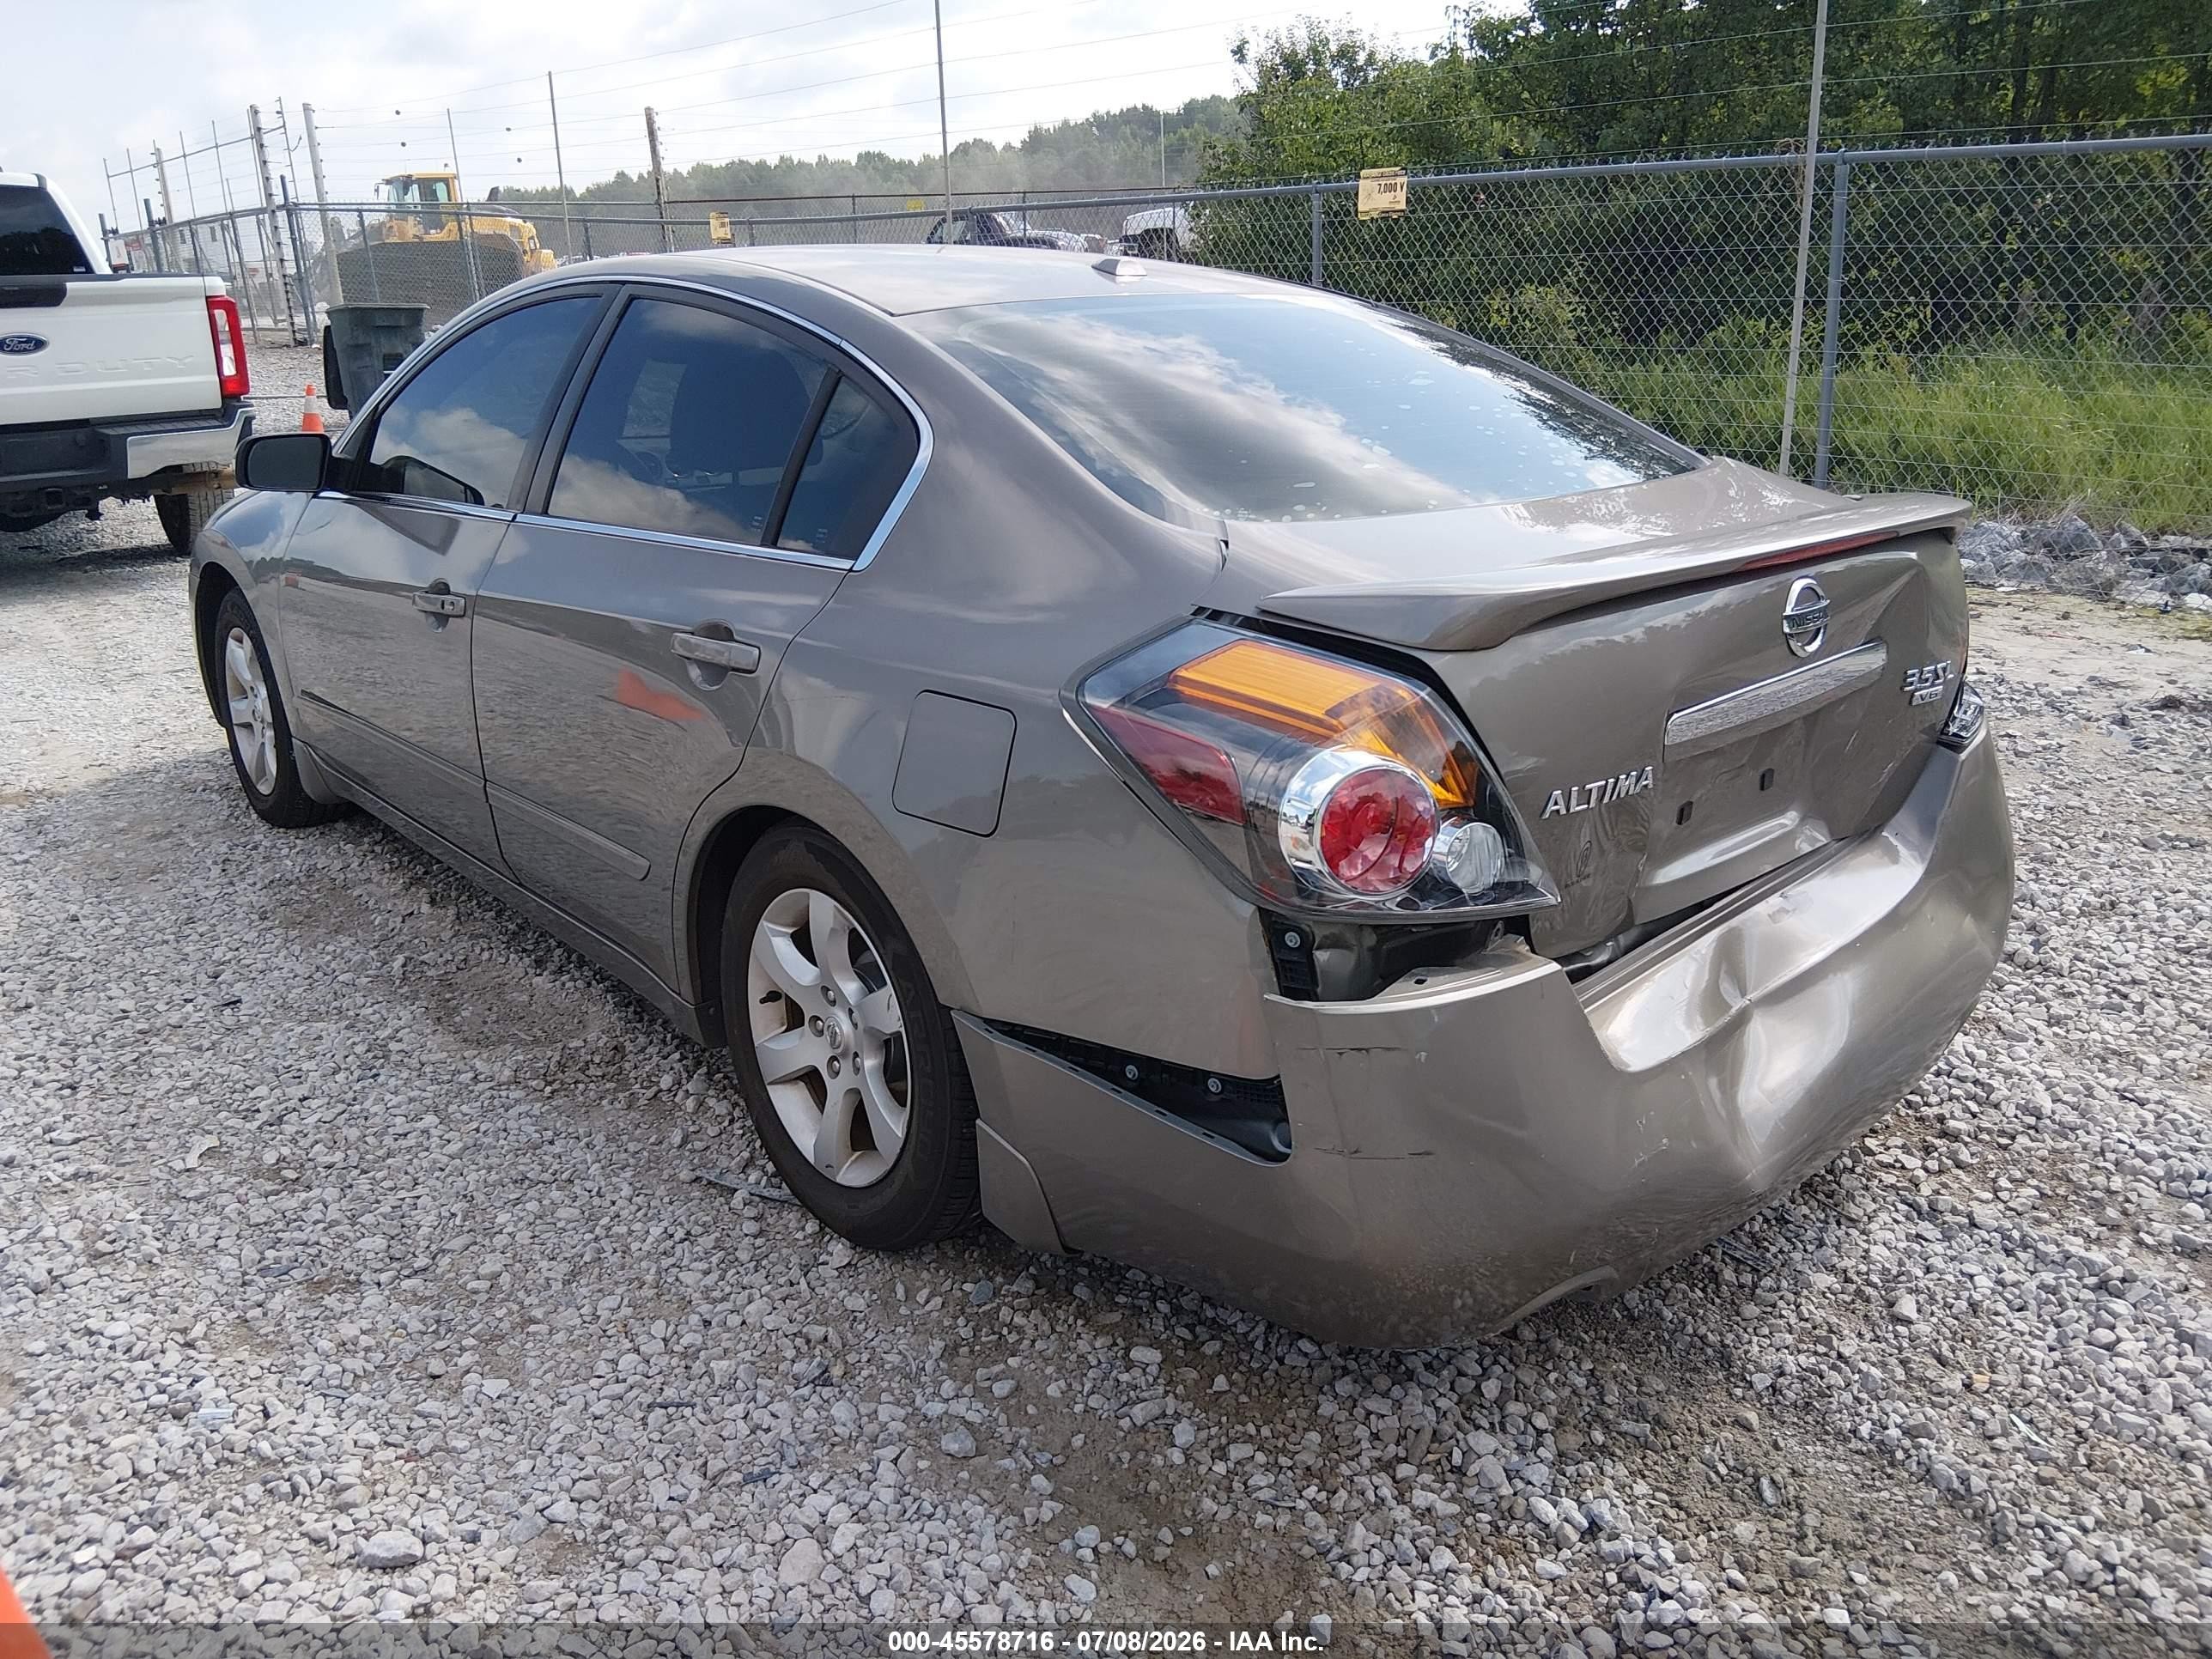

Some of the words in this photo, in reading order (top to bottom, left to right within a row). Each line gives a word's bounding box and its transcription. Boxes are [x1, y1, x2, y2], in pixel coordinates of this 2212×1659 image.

[1377, 182, 1397, 195] 7,000
[1400, 181, 1405, 192] V
[3, 337, 36, 351] Ford
[55, 355, 195, 376] DUTY
[1919, 689, 1938, 702] V6
[1540, 766, 1654, 819] ALTIMA
